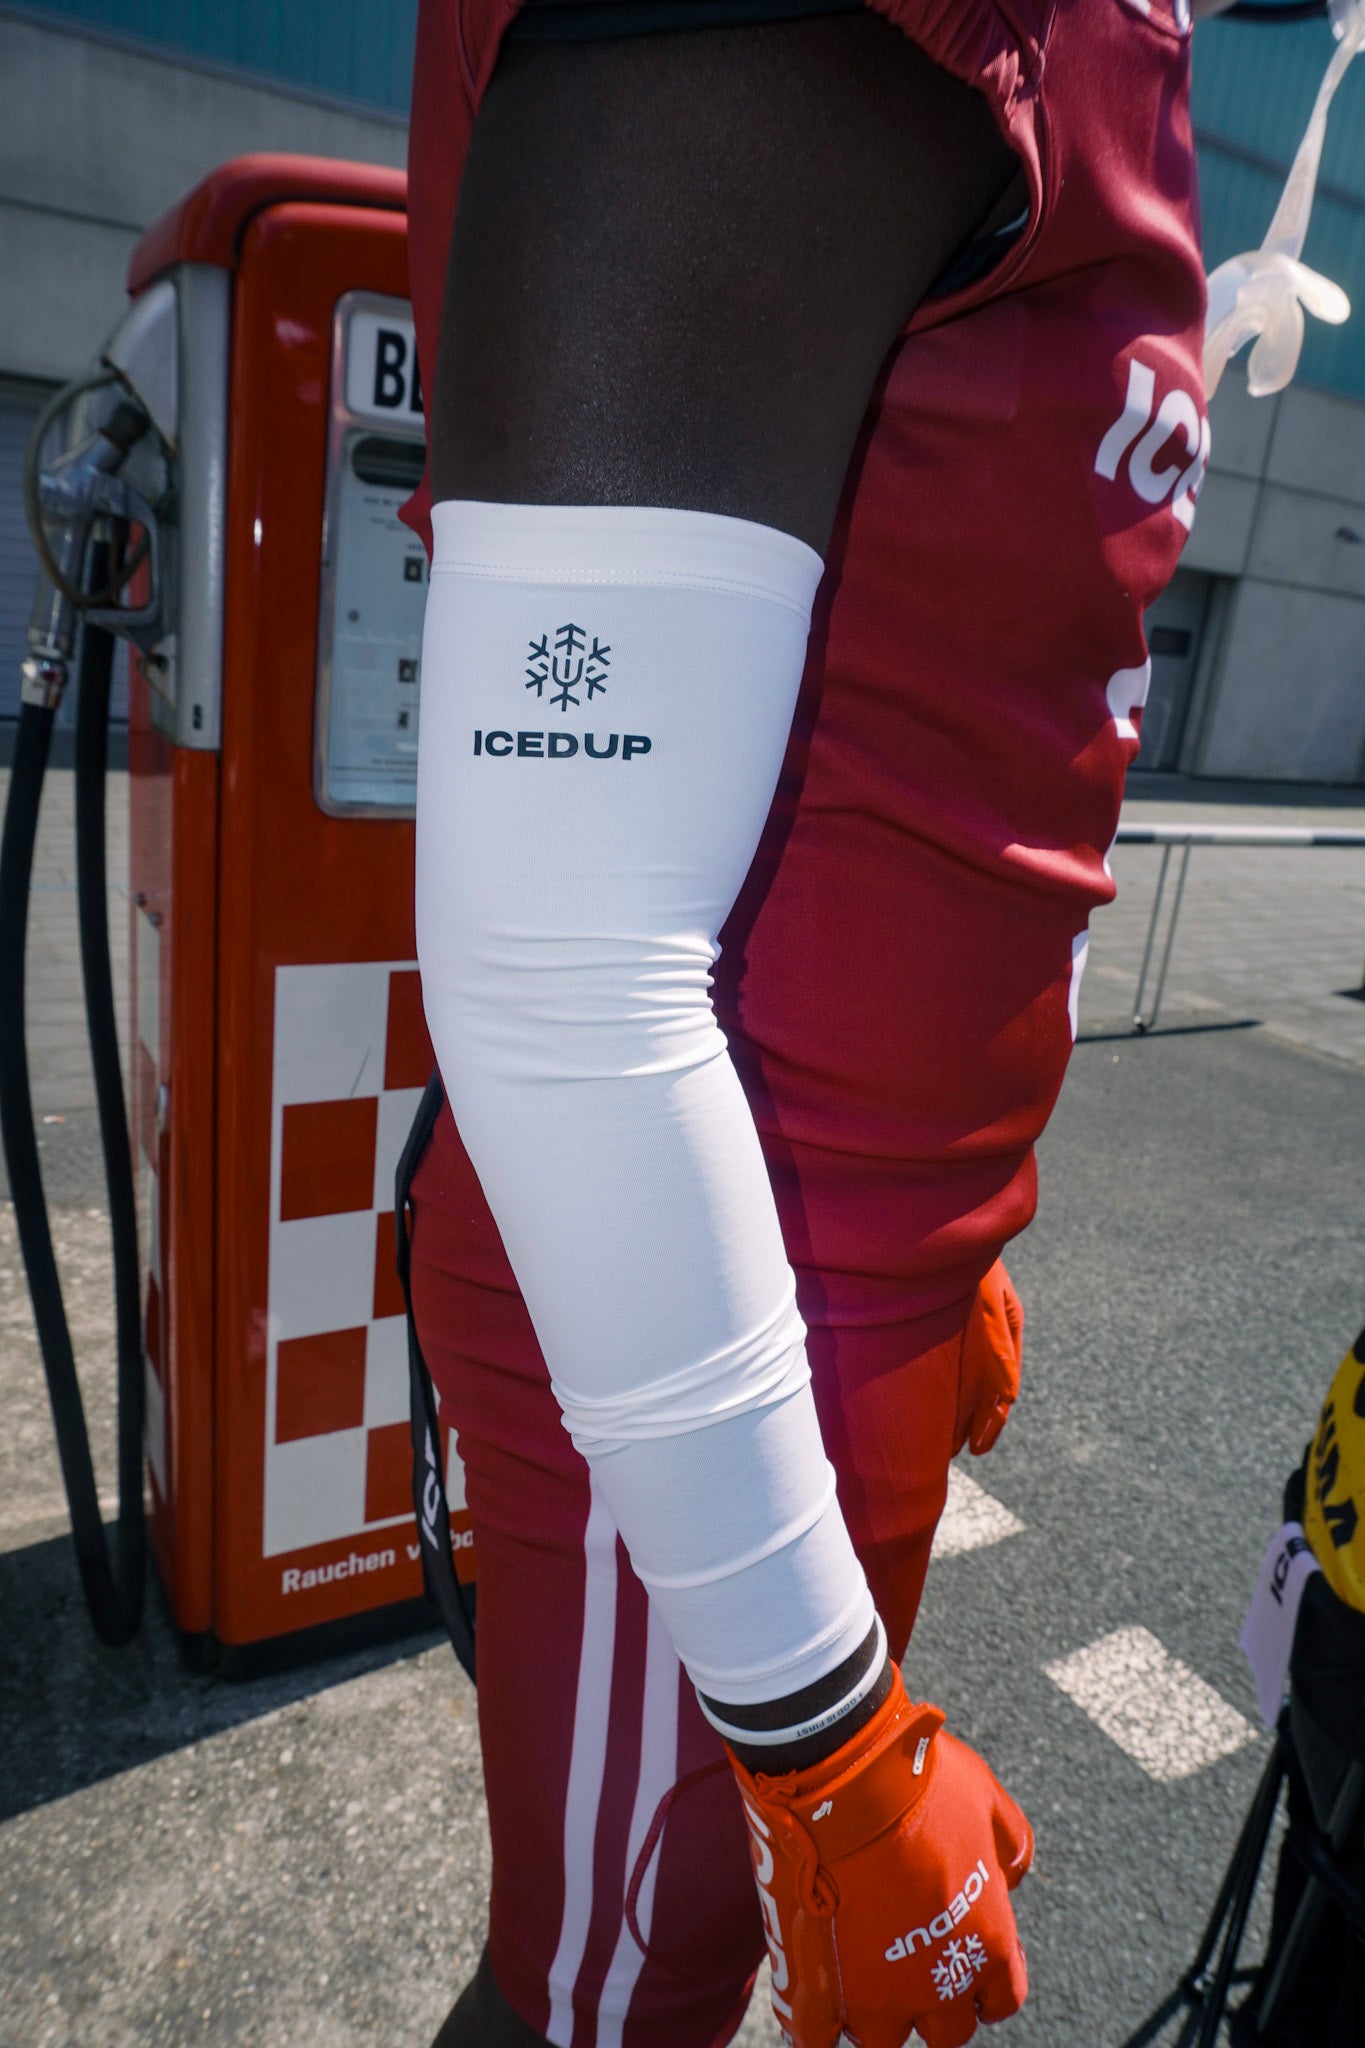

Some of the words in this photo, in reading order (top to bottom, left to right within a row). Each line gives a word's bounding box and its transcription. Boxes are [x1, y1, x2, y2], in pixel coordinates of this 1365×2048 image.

[281, 1548, 396, 1594] Rauchen
[796, 1720, 825, 1738] FIRST
[885, 1859, 989, 1962] ICEDUP
